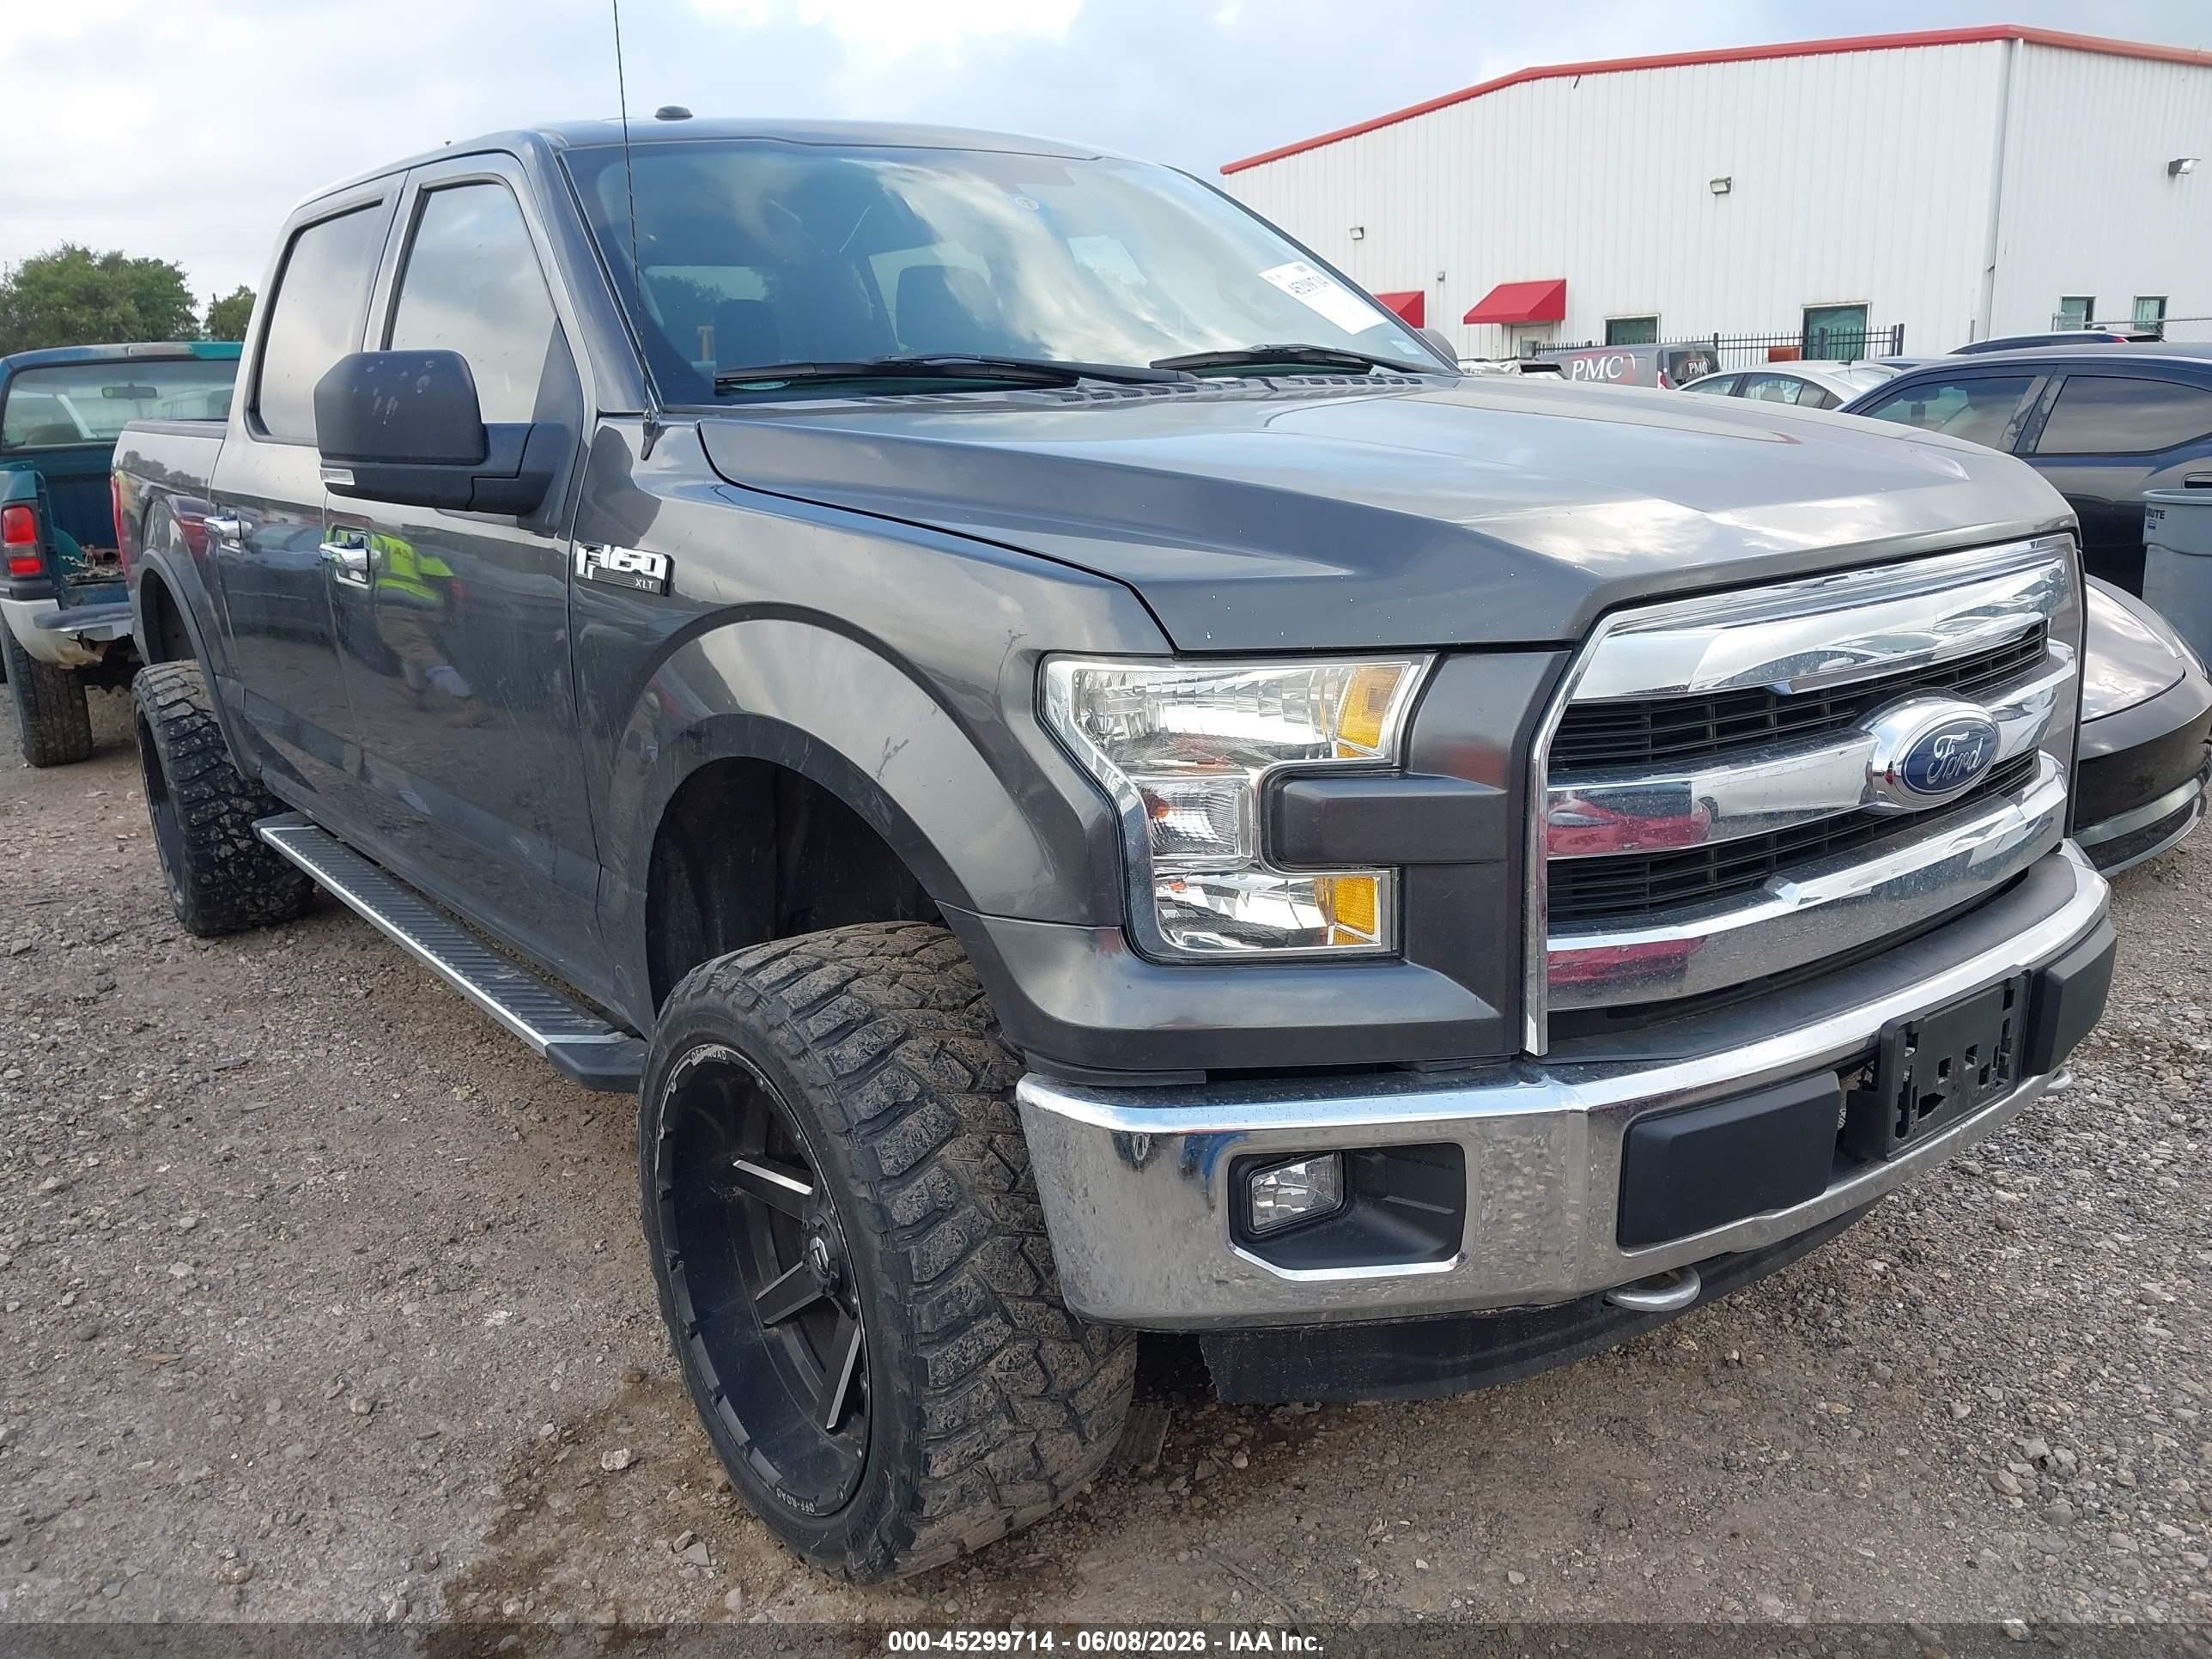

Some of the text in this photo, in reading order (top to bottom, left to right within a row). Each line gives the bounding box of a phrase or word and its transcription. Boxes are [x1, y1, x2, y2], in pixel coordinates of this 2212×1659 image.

[1571, 356, 1624, 380] PMC
[1688, 361, 1708, 374] PMC
[635, 578, 654, 591] XLT
[1926, 731, 1984, 785] Ford
